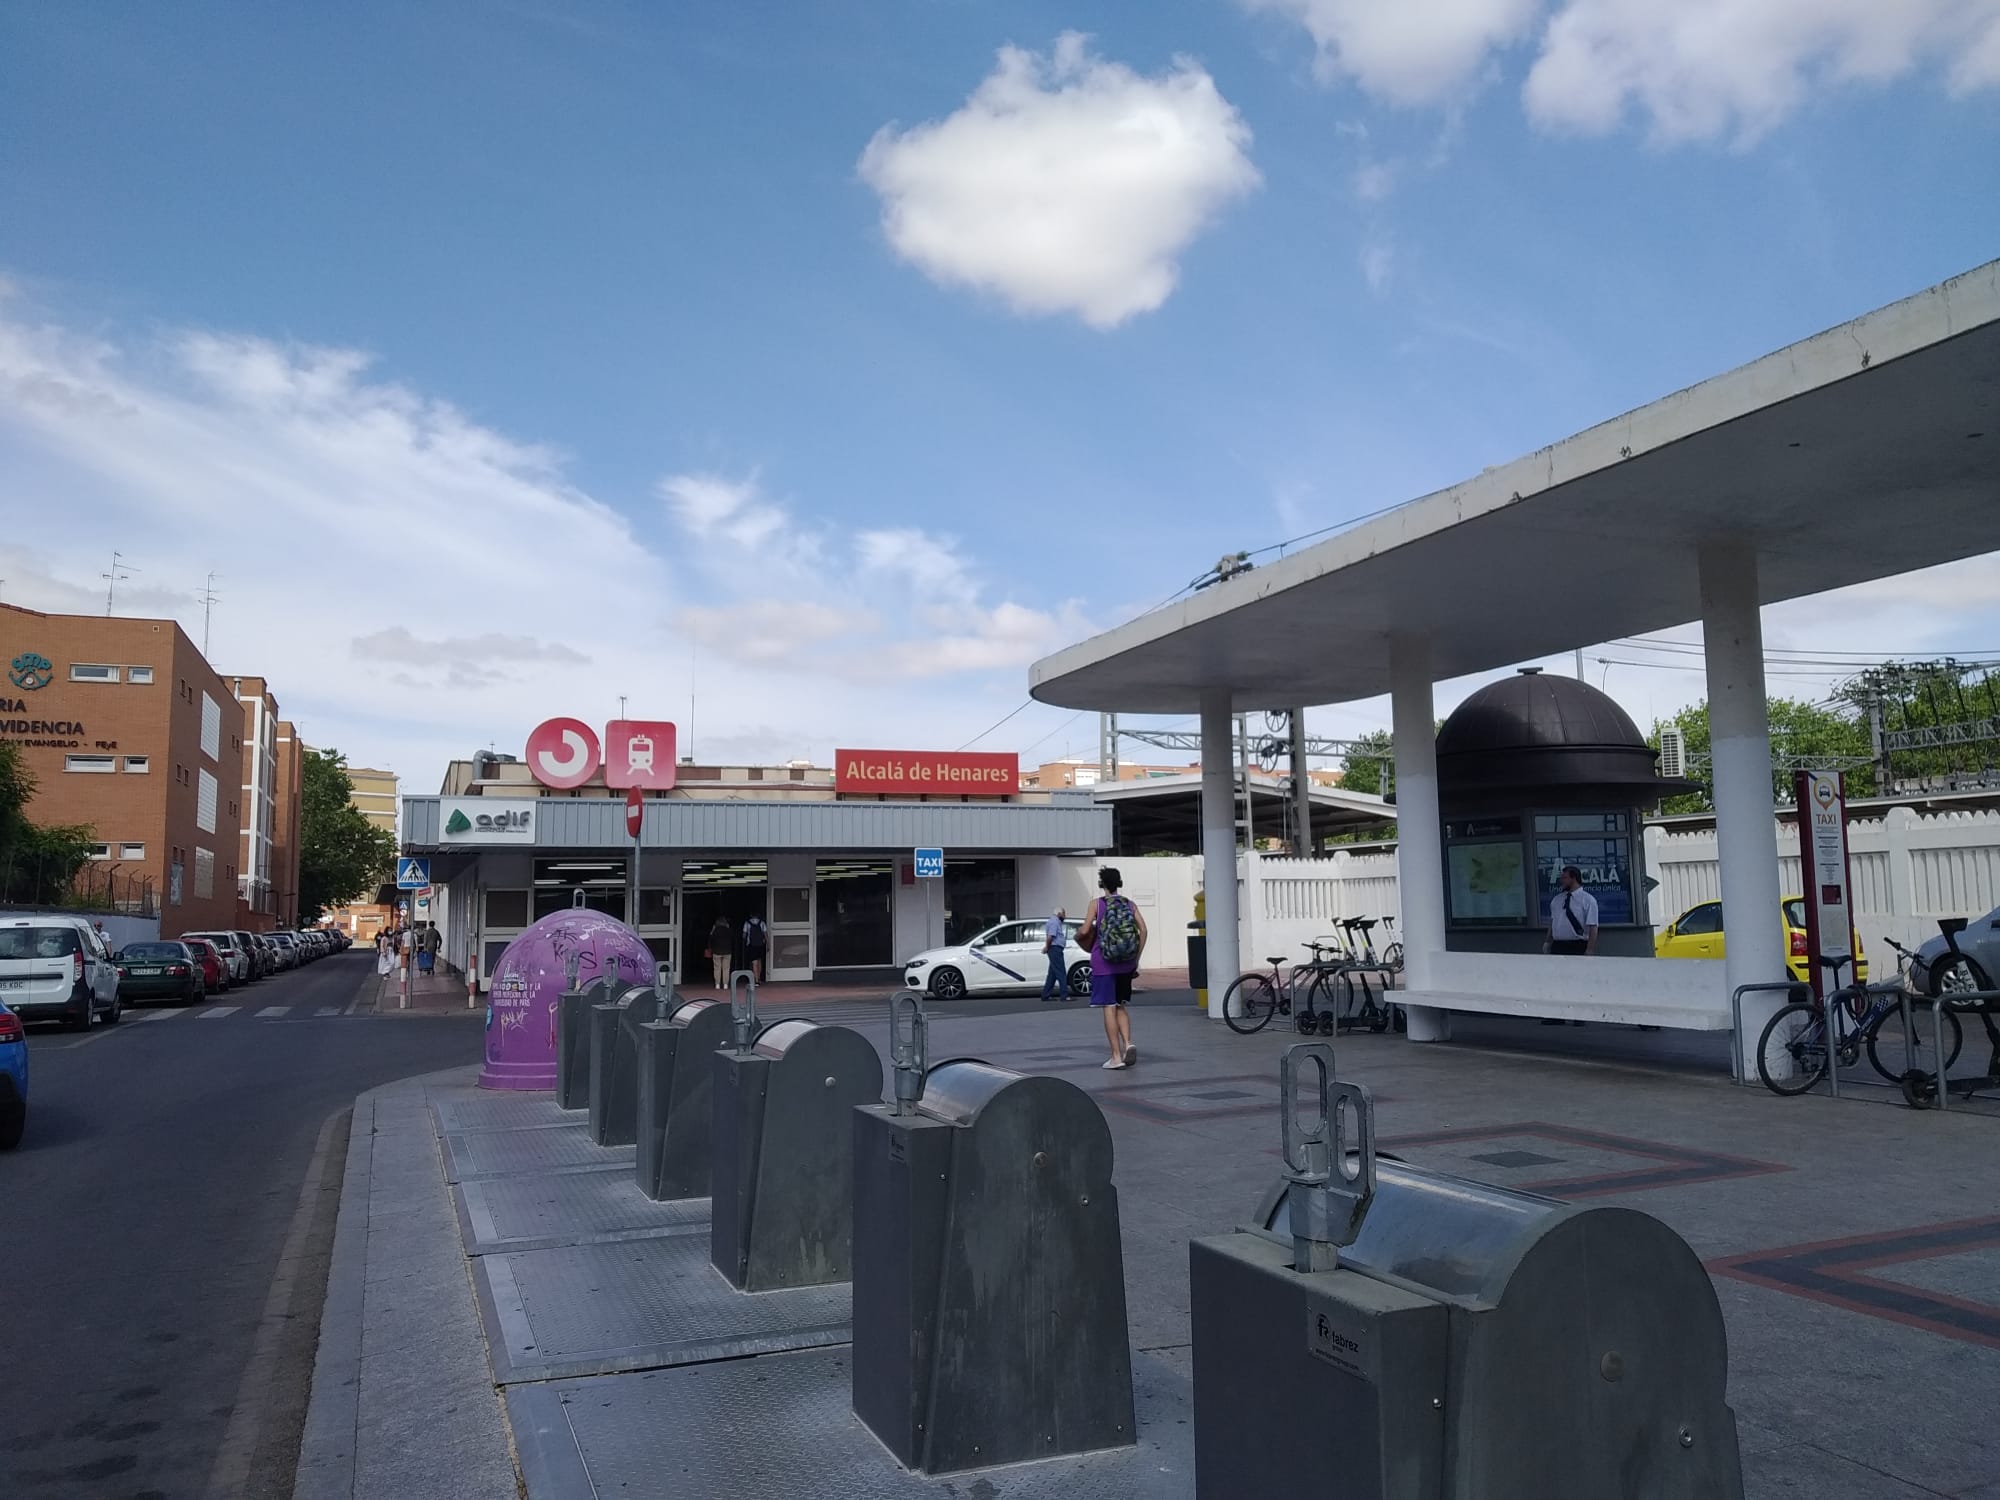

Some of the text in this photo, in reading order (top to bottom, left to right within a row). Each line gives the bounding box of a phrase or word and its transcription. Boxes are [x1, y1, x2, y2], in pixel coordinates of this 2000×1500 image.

[0, 720, 85, 736] VIDENCIA
[25, 739, 79, 748] EVANGELIO
[95, 741, 118, 750] FEyE
[846, 760, 1009, 782] Alcalá de Henares
[475, 809, 531, 827] adif
[1815, 813, 1837, 825] TAXI
[917, 857, 942, 868] TAXI
[1549, 857, 1620, 884] ACALÁ
